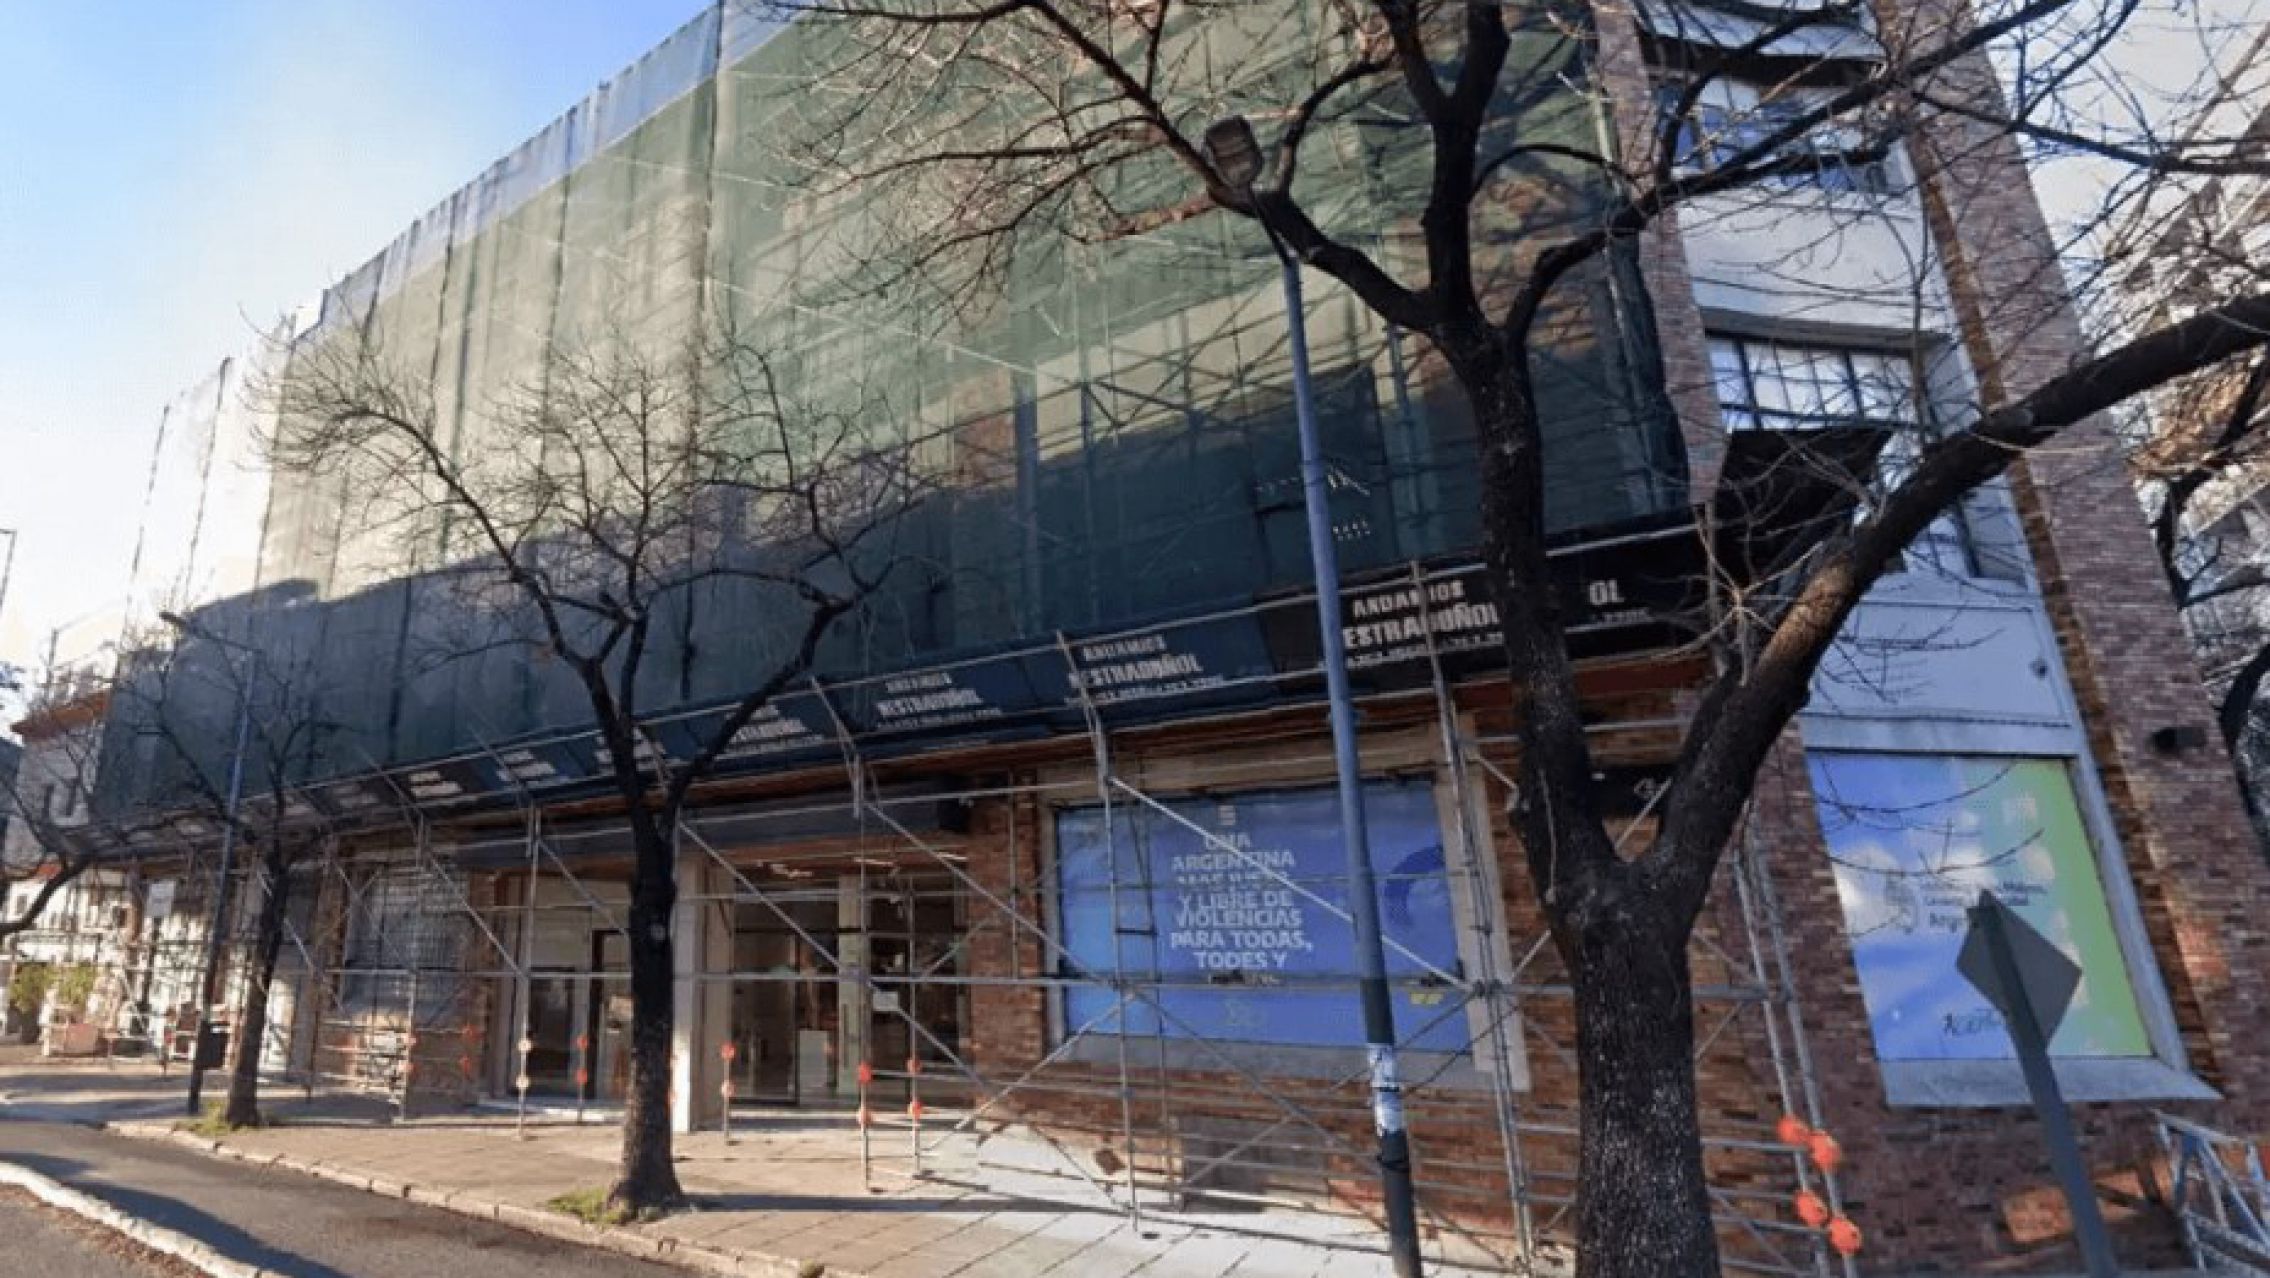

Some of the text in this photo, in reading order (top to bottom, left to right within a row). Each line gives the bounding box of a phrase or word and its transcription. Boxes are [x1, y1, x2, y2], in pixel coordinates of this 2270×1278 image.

[1178, 889, 1293, 909] Y LIBRE DE
[1176, 908, 1302, 927] VIOLENCIAS
[1171, 930, 1312, 952] PARA TODAS,
[1193, 951, 1288, 969] TODES Y
